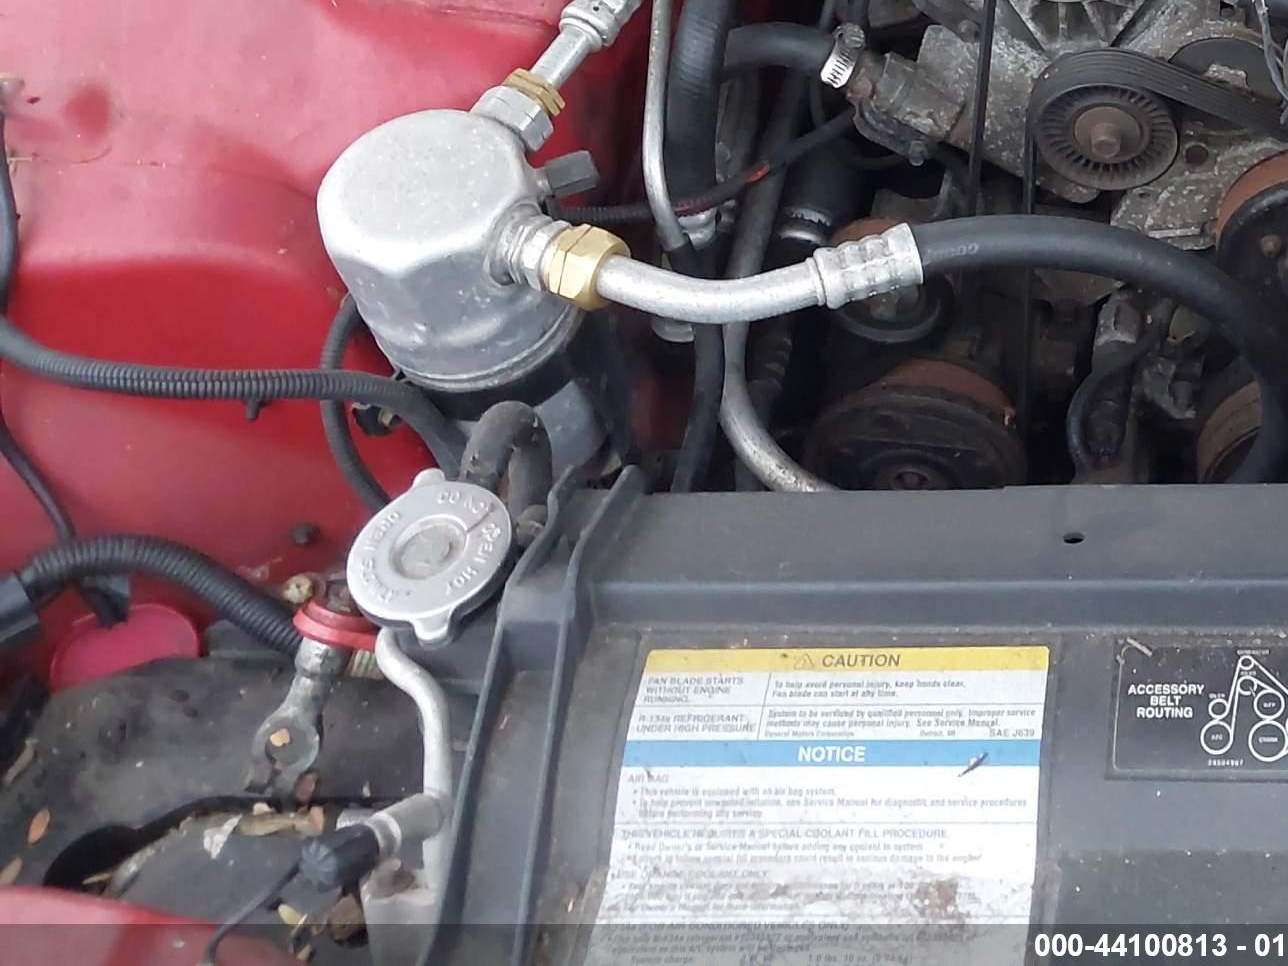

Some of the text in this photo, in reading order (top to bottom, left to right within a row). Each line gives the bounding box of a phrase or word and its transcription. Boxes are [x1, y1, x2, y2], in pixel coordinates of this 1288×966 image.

[437, 491, 460, 505] DO
[821, 653, 901, 668] CAUTION
[647, 686, 730, 694] WITHOUT ENGINE
[785, 681, 803, 689] help
[805, 681, 828, 689] avoid
[830, 681, 864, 689] personal
[916, 681, 941, 689] hands
[1127, 684, 1205, 695] ACCESSORY
[1150, 695, 1182, 706] BELT
[768, 710, 797, 718] System
[809, 710, 819, 718] be
[856, 710, 865, 718] by
[905, 710, 944, 718] personnel
[968, 710, 1005, 718] Improper
[1007, 710, 1036, 718] service
[1136, 707, 1194, 718] ROUTING
[673, 714, 744, 722] REFRIGERANT
[637, 723, 757, 733] UNDER HIGH PRESSURE
[803, 720, 820, 729] may
[822, 720, 847, 729] cause
[849, 720, 884, 729] personal
[916, 719, 932, 727] See
[935, 719, 965, 727] Service
[990, 730, 1009, 738] SAE
[797, 745, 867, 763] NOTICE
[628, 774, 646, 783] AIR
[702, 786, 740, 797] equipped
[788, 786, 803, 795] bag
[837, 798, 868, 807] Manual
[930, 798, 945, 807] and
[948, 798, 977, 807] service
[980, 798, 1027, 807] procedures
[758, 829, 801, 838] SPECIAL
[804, 829, 855, 838] COOLANT
[858, 829, 880, 838] FILL
